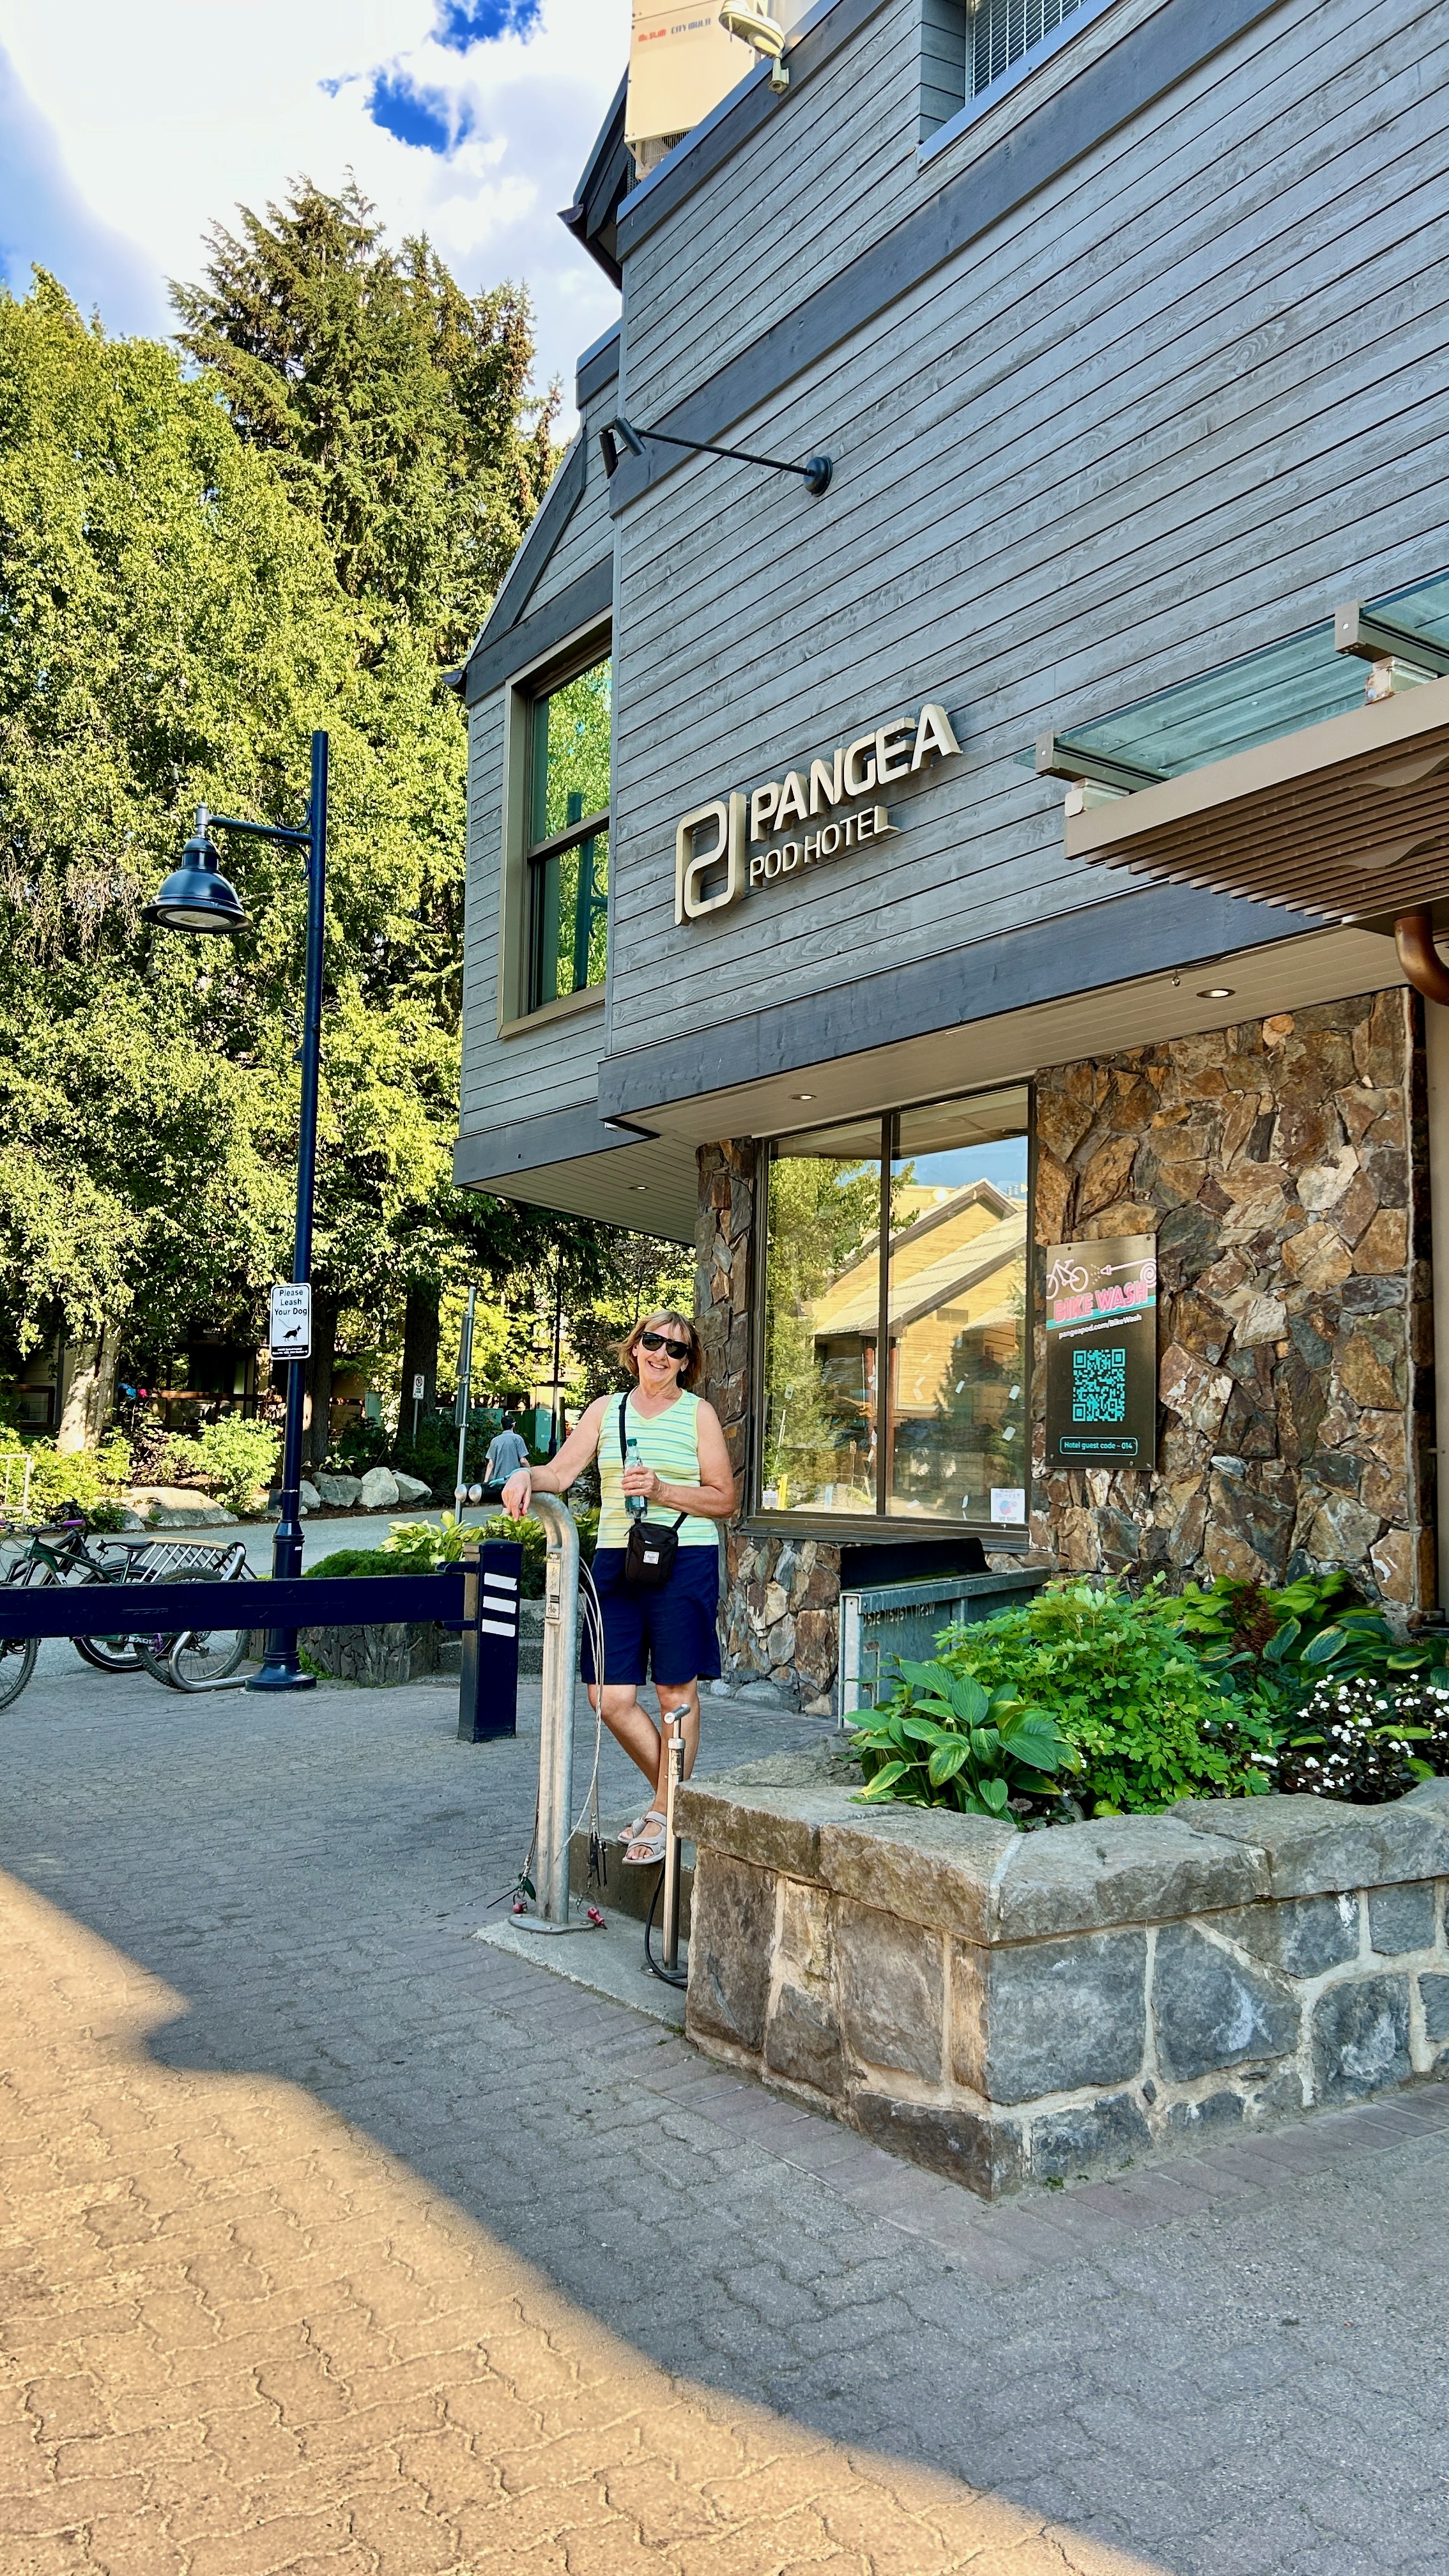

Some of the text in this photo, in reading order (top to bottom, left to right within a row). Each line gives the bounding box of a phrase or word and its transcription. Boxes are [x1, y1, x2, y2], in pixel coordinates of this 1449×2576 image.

[750, 703, 963, 842] PANGEA
[749, 805, 898, 888] POD HOTEL
[293, 1307, 307, 1316] Dog
[1054, 1280, 1148, 1323] BIKE WASH
[1081, 1442, 1099, 1450] guest
